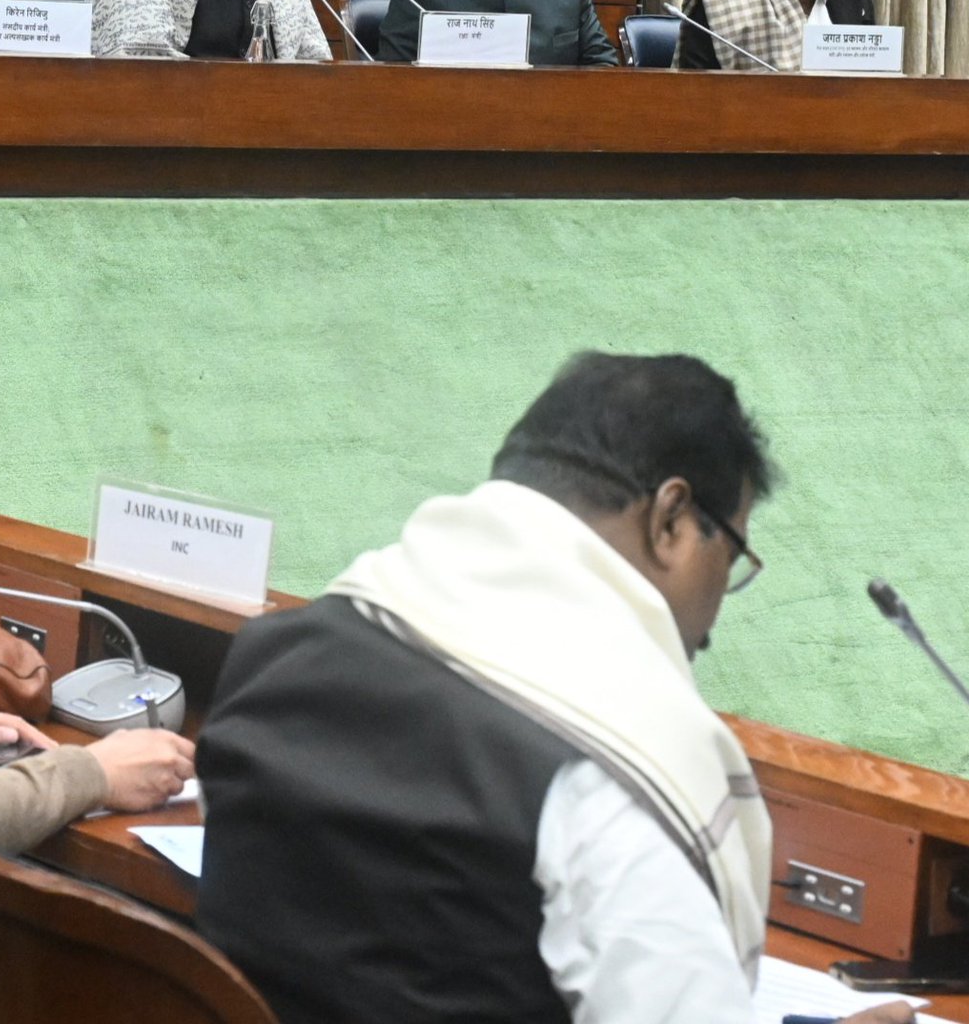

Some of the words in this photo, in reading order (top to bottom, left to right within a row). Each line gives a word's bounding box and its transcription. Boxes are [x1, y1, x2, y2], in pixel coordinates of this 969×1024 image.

[5, 6, 25, 17] किरेन
[446, 18, 461, 28] राज
[463, 18, 478, 28] नाथ
[480, 16, 495, 29] सिंह
[822, 33, 841, 43] जगत
[843, 34, 866, 43] प्रकाश
[124, 499, 179, 525] JAIRAM
[182, 513, 244, 540] RAMESH
[171, 540, 190, 555] INC
